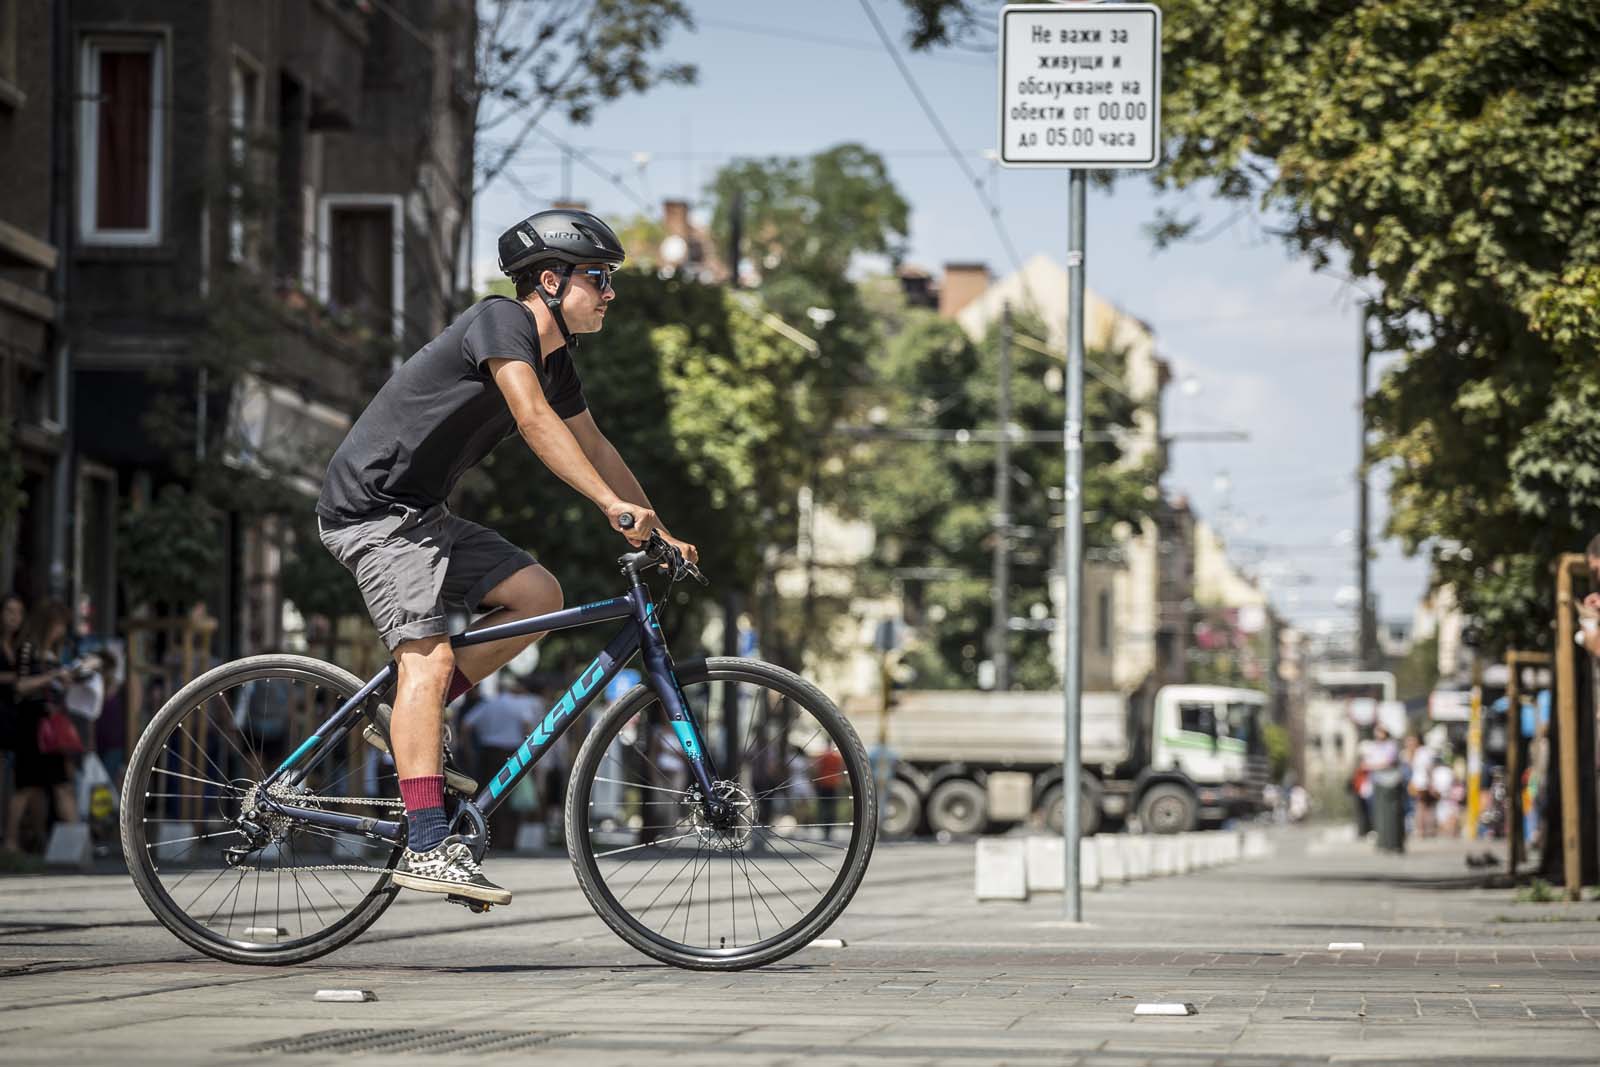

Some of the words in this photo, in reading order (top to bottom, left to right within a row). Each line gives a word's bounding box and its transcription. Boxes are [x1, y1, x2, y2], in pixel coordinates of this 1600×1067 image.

[1031, 25, 1051, 43] Не
[1060, 29, 1101, 43] важи
[1110, 29, 1128, 43] за
[1038, 56, 1103, 74] живущи
[1112, 56, 1122, 68] и
[1018, 76, 1113, 99] обслужване
[1121, 82, 1140, 95] на
[1011, 102, 1065, 120] обекти
[1073, 107, 1090, 120] от
[1098, 102, 1147, 120] 00.00
[1018, 133, 1037, 147] до
[1046, 128, 1094, 147] 05.00
[1099, 133, 1136, 147] часа
[488, 657, 606, 800] DRAG
